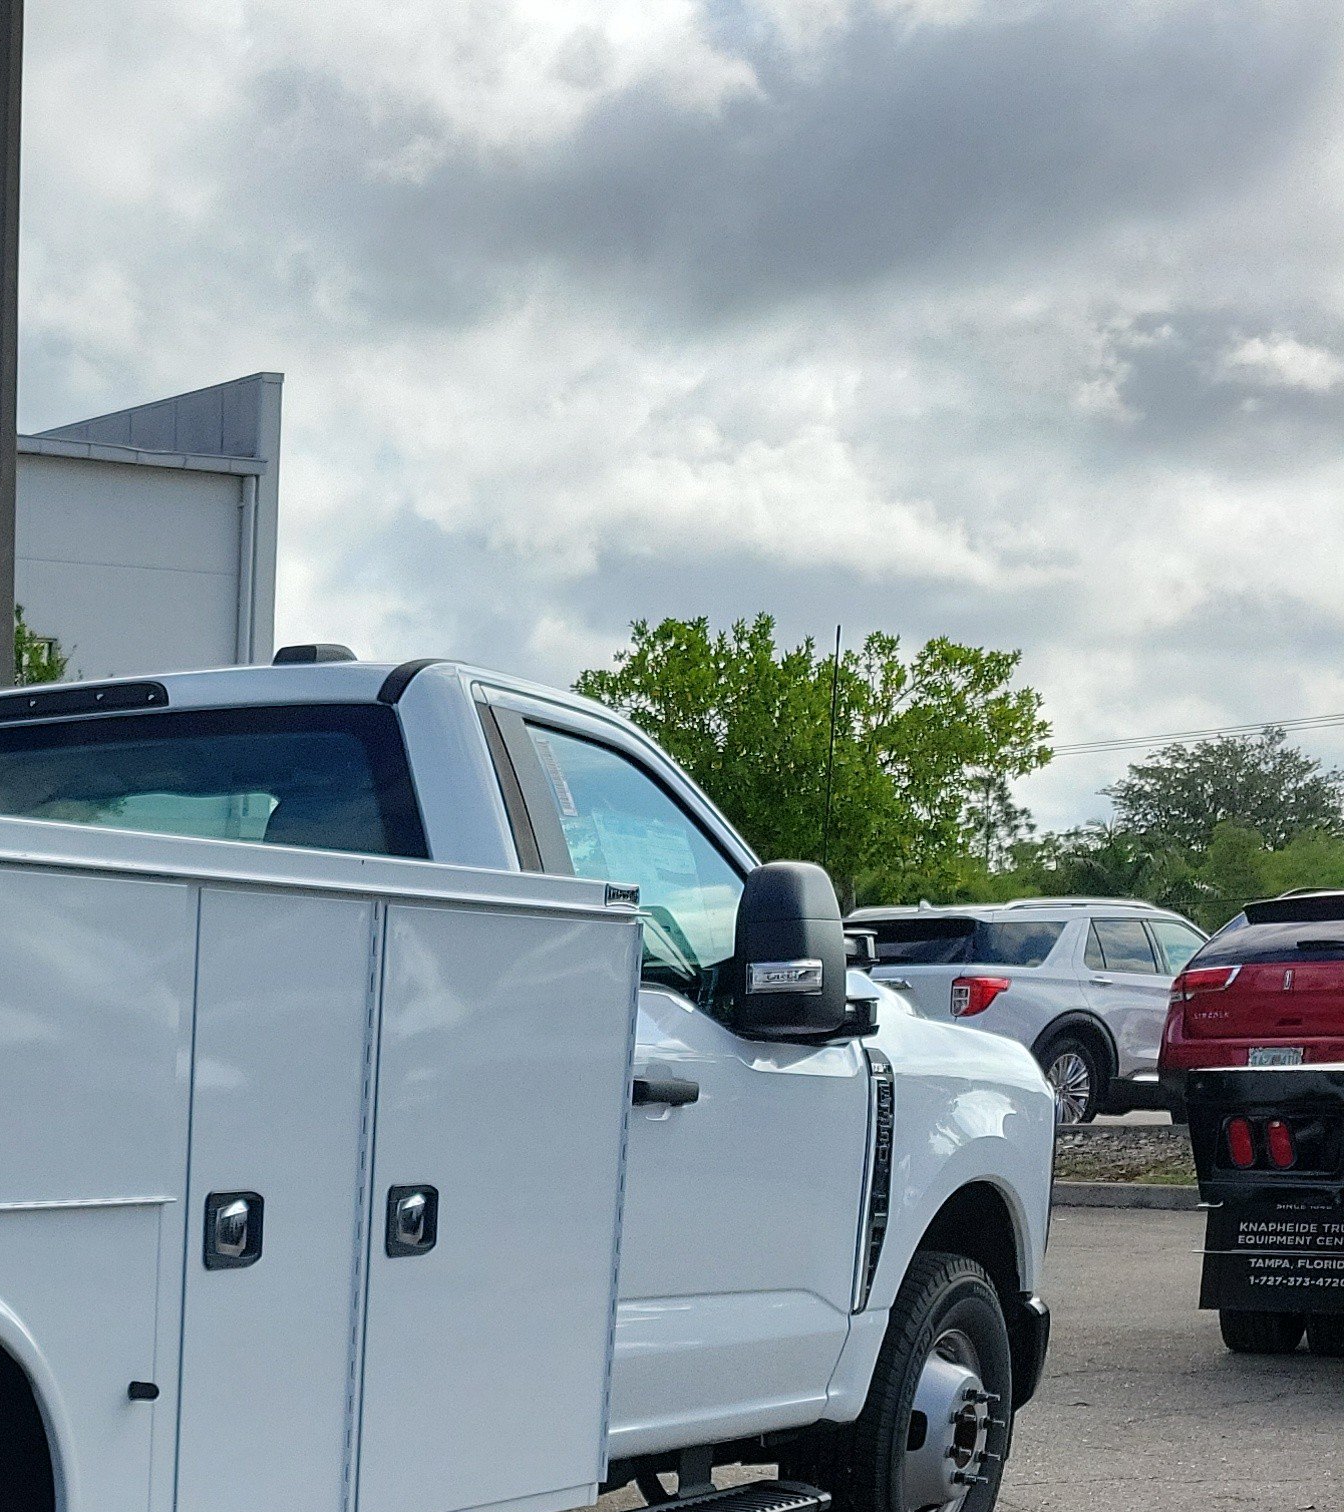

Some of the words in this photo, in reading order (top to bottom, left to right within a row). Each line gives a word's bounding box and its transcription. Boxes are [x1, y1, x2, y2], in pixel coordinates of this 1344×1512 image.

[1239, 1221, 1318, 1233] KNAPHEIDE
[1237, 1234, 1313, 1246] EQUIPMENT
[1248, 1258, 1294, 1270] TAMPA,
